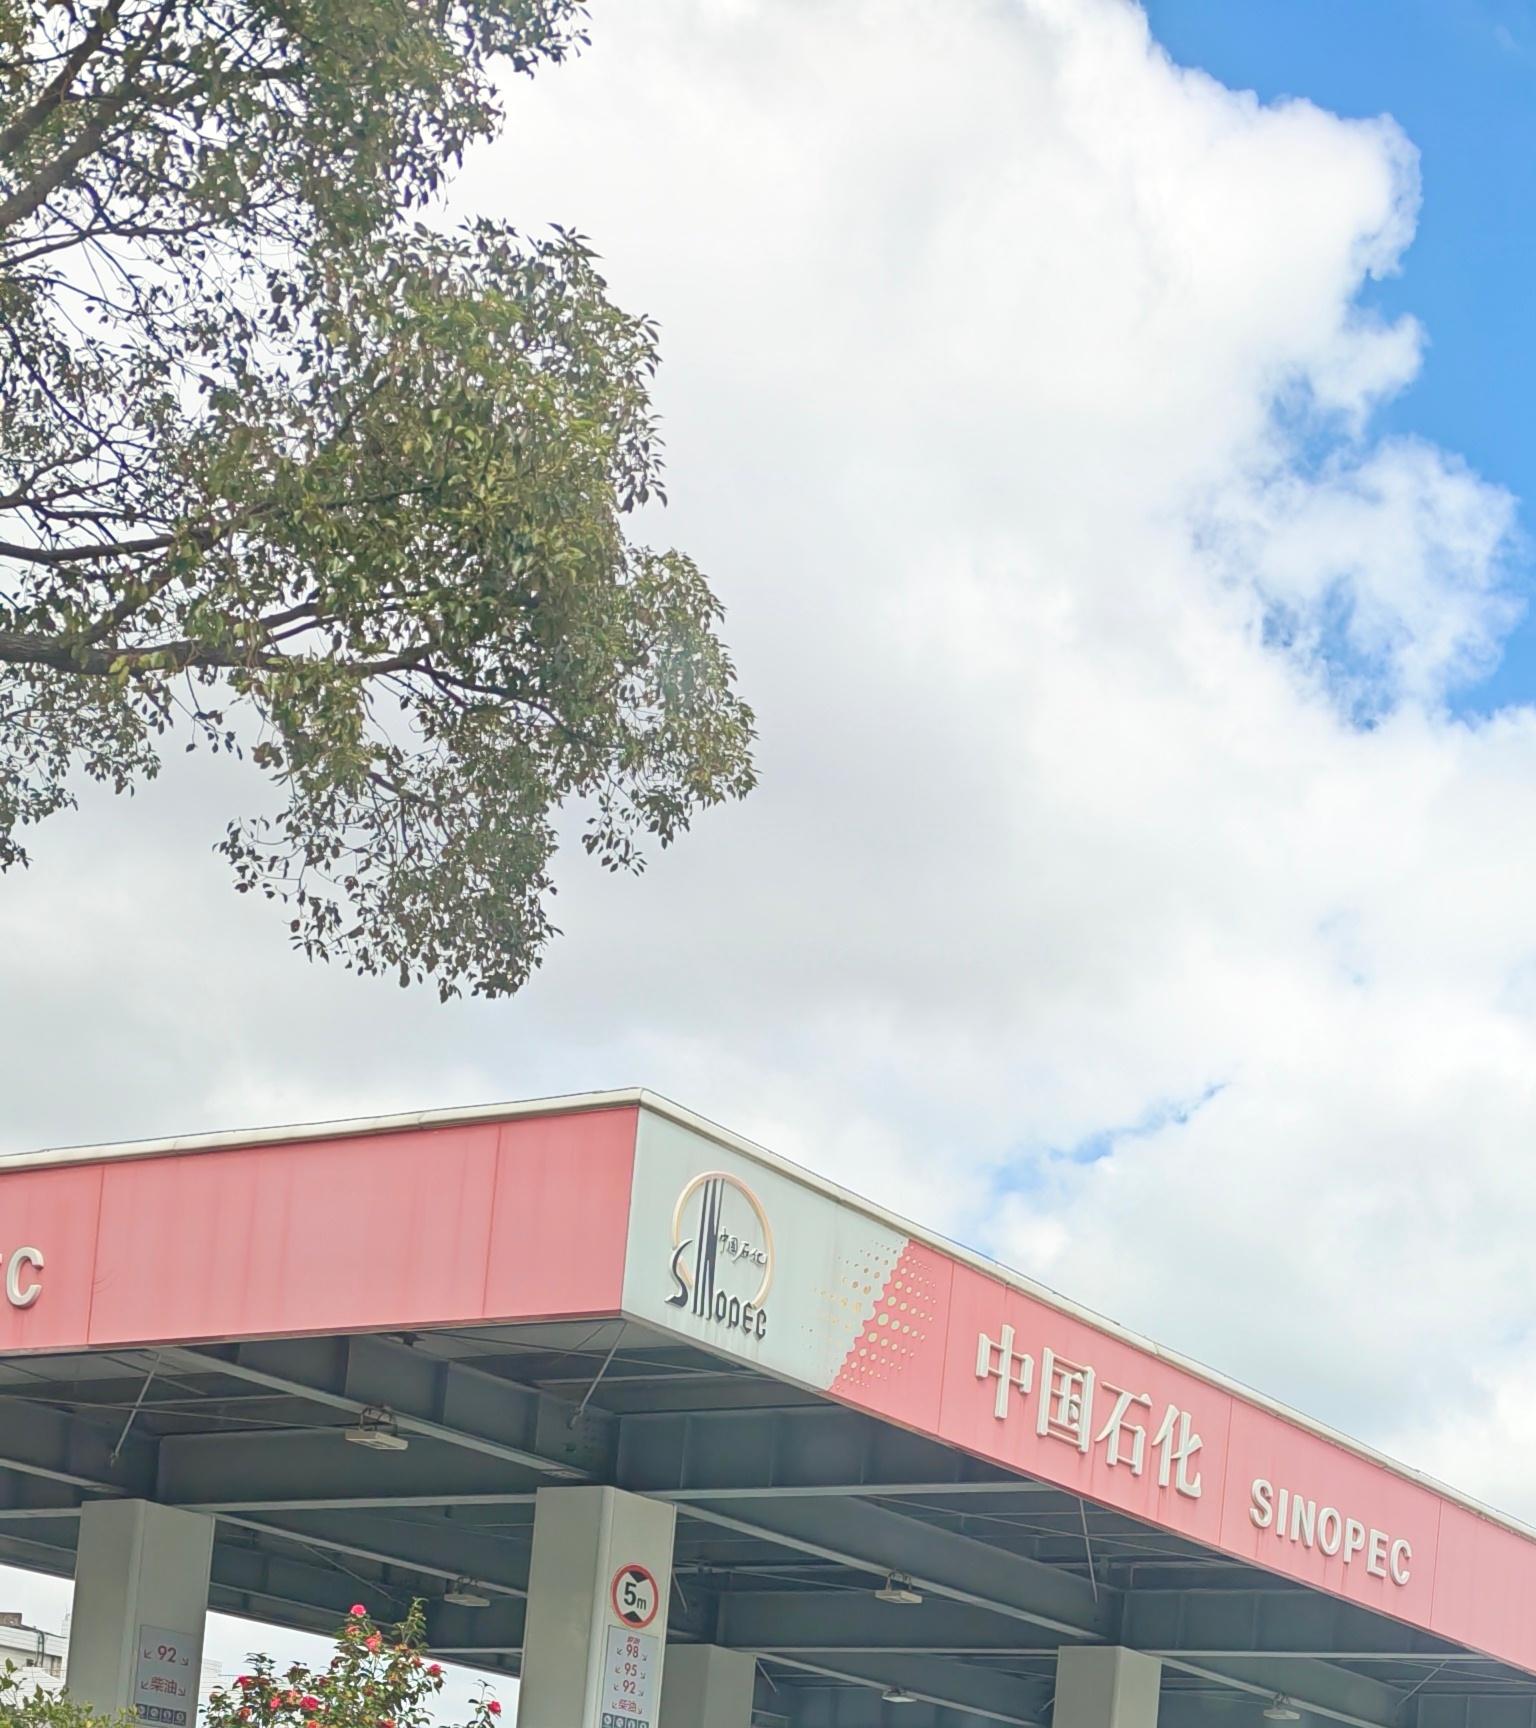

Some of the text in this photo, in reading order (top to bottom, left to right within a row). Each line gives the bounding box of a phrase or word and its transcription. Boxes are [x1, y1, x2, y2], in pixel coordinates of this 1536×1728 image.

[718, 1226, 768, 1265] 中国石化
[975, 1323, 1204, 1499] 中国石化
[1249, 1478, 1413, 1587] SINOPEC
[623, 1581, 647, 1610] 5m
[157, 1645, 177, 1664] 92
[625, 1643, 639, 1659] 98
[624, 1662, 638, 1678] 95
[150, 1676, 178, 1695] 柴油
[622, 1679, 636, 1695] 92
